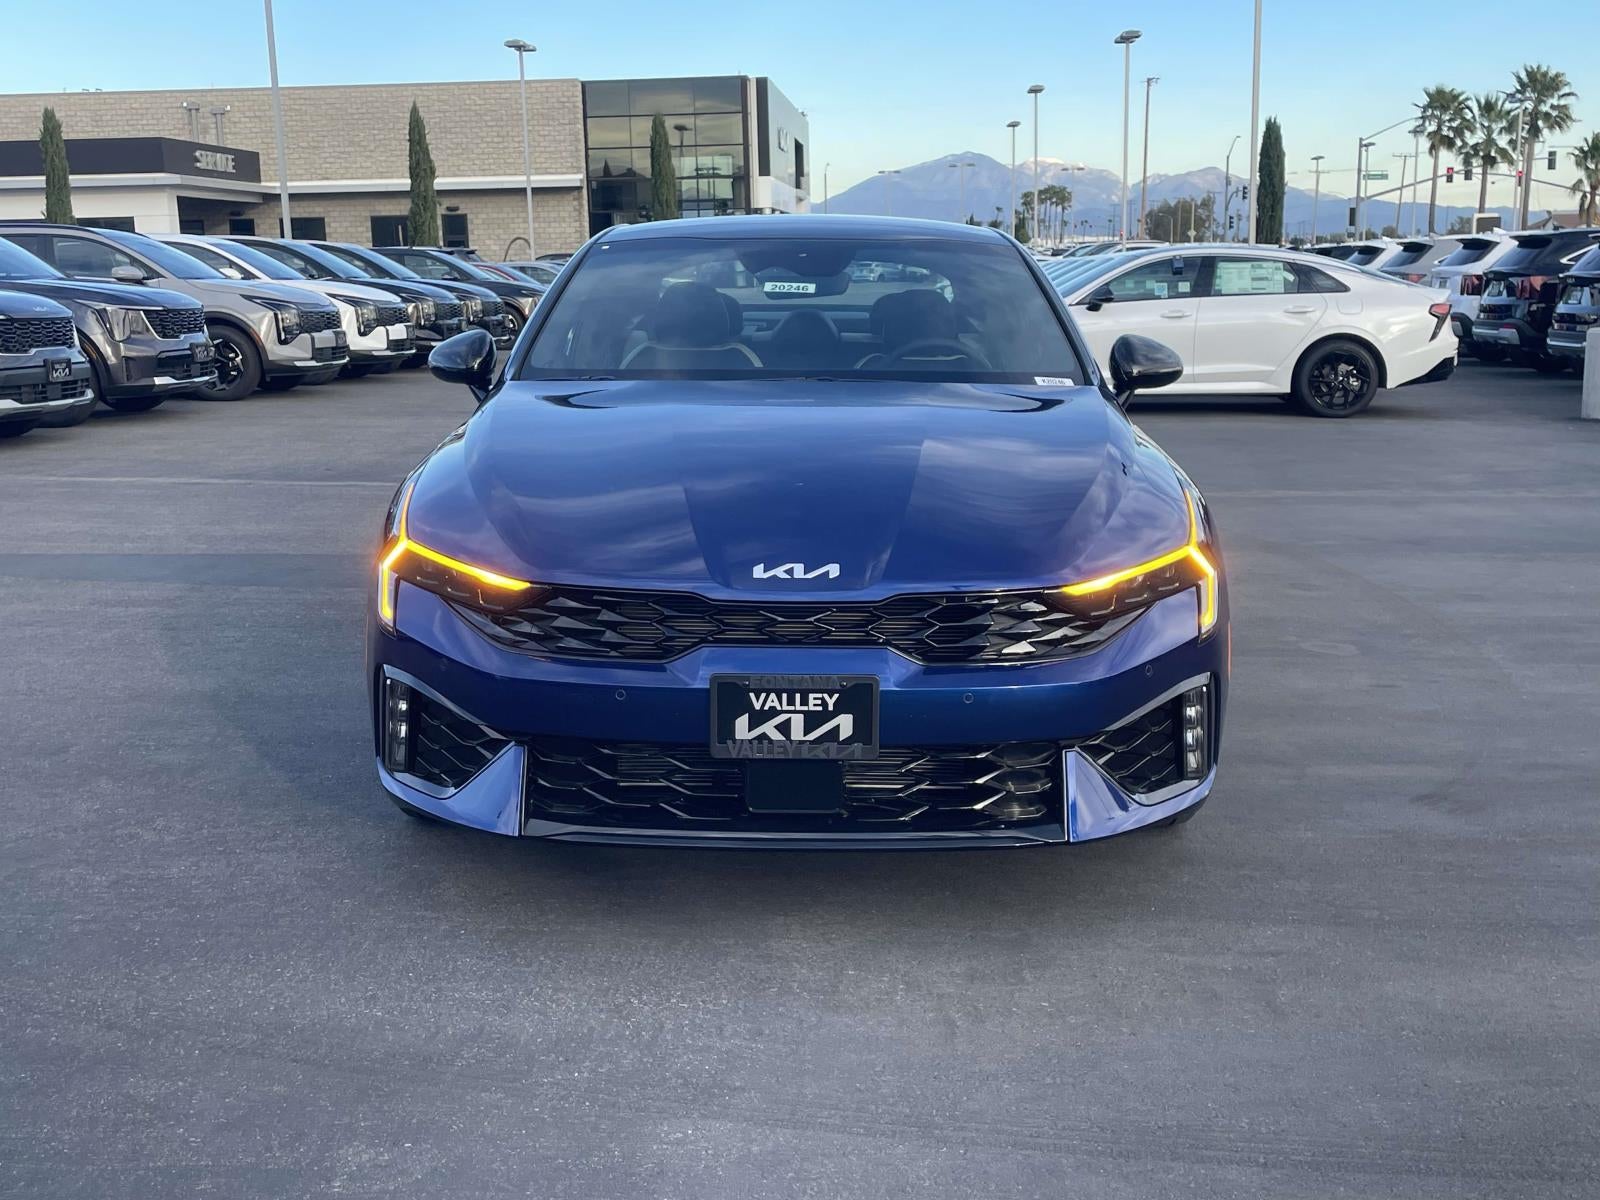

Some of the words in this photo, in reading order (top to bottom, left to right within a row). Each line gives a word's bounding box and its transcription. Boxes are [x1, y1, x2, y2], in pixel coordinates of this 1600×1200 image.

[770, 284, 809, 292] 20246
[752, 563, 840, 579] KIA
[750, 676, 841, 688] FONTANA
[749, 692, 840, 711] VALLEY
[735, 713, 854, 742] KIA
[726, 740, 799, 758] VALLEY
[800, 742, 863, 758] KIA
